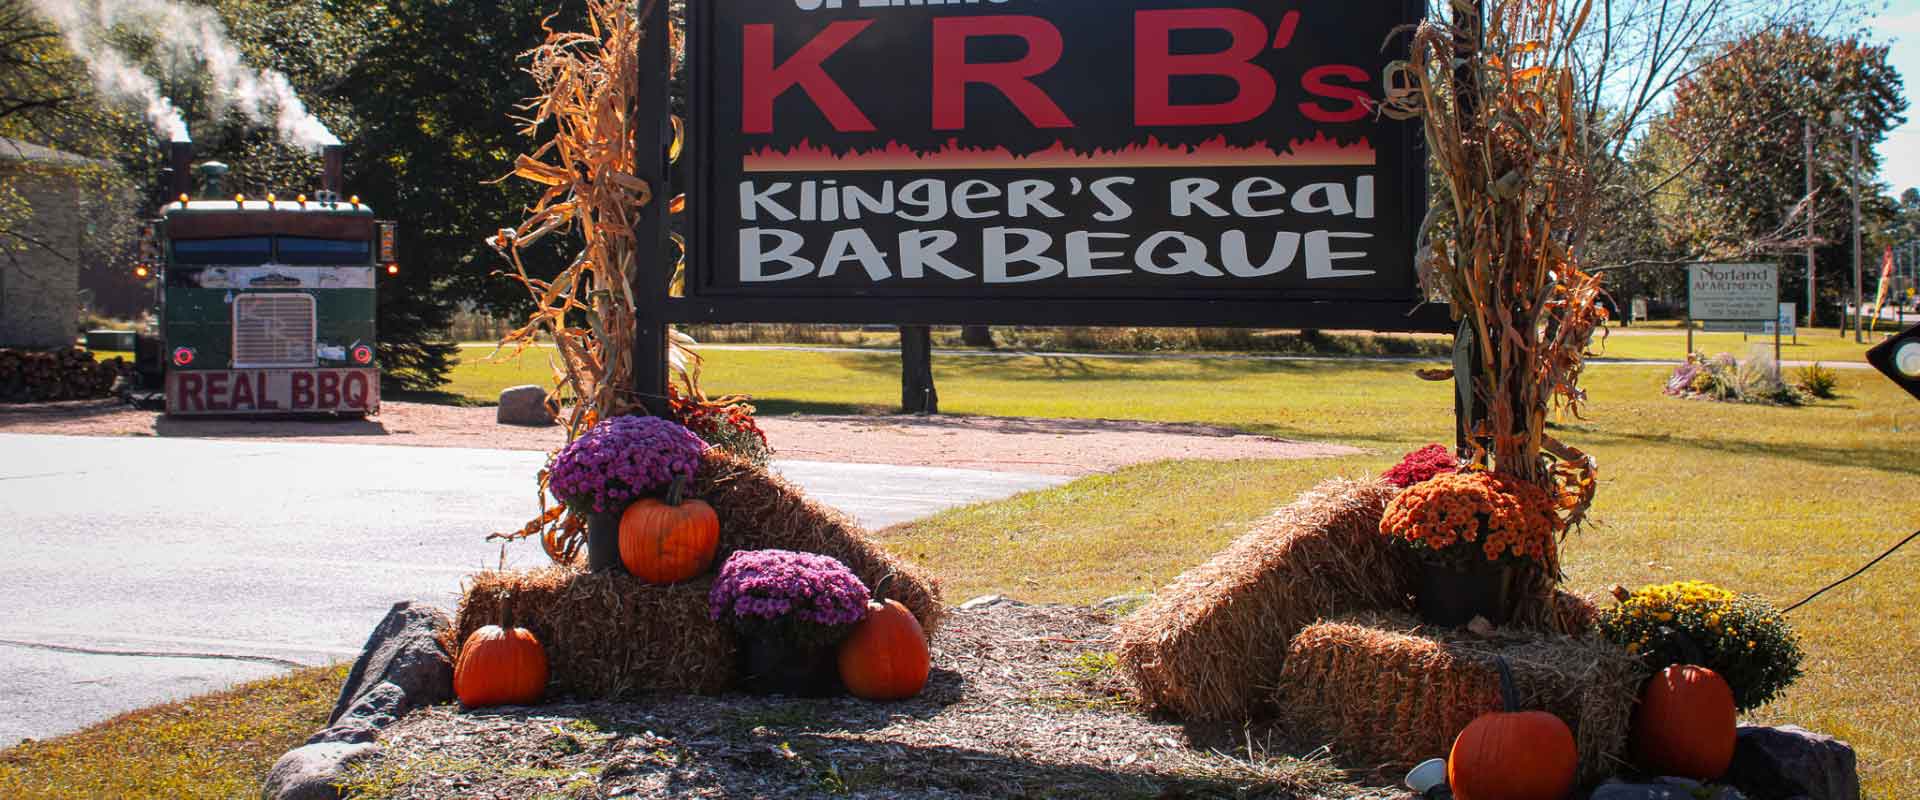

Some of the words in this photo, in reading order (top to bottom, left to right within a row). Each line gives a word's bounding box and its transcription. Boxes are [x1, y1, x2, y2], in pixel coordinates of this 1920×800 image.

[1170, 175, 1375, 219] Real
[739, 226, 1377, 283] BARBEQUE
[1700, 267, 1768, 280] Norland
[1694, 281, 1773, 290] APARTMENTS
[179, 371, 278, 411] REAL
[291, 371, 369, 410] BBQ
